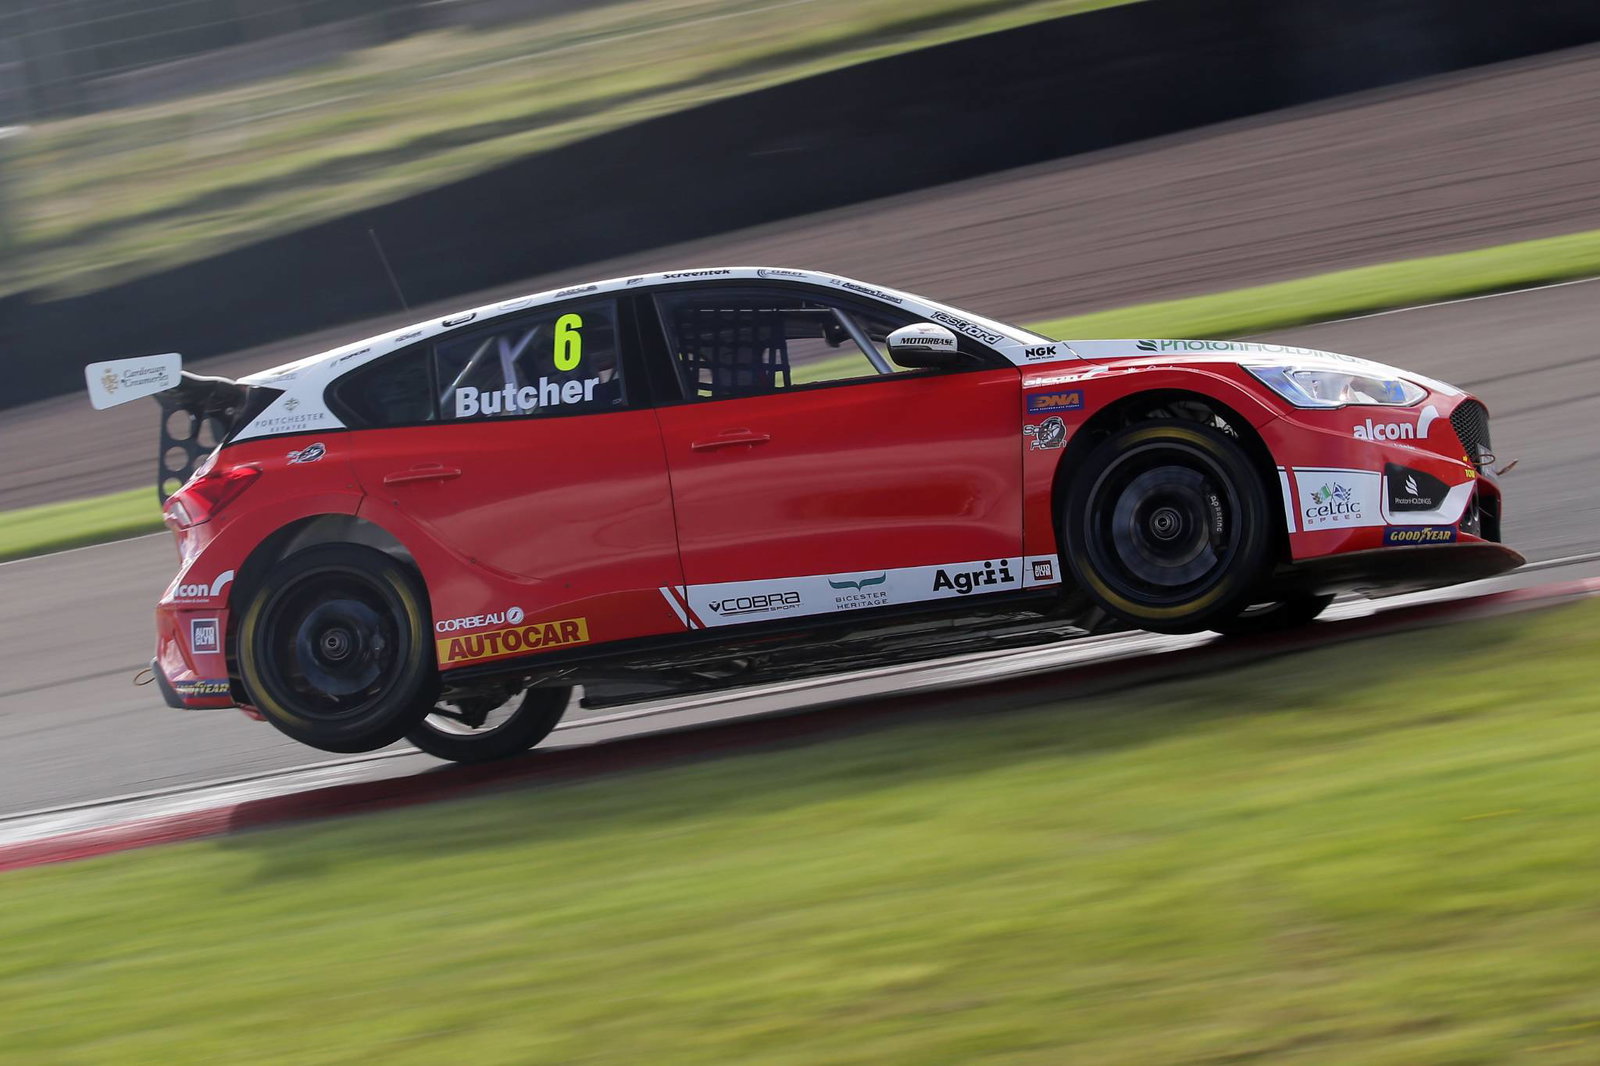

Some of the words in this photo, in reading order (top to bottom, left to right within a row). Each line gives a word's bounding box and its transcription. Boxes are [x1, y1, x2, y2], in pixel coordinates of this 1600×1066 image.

[662, 269, 731, 280] Screentek
[553, 313, 583, 372] 6
[900, 337, 954, 346] MOTORBASE
[1025, 346, 1057, 358] NGK
[455, 376, 600, 417] Butcher
[1035, 393, 1080, 408] DNA
[255, 412, 324, 428] PORTCHESTER
[270, 423, 307, 433] ESTATES
[1353, 418, 1414, 441] alcon
[1307, 513, 1362, 525] SPEED
[1390, 527, 1452, 543] GOODYEAR
[932, 559, 1015, 595] Agrii
[835, 591, 888, 603] BICESTER
[836, 599, 889, 610] HERITAGE
[770, 604, 800, 612] SPORT
[435, 612, 506, 634] CORBEAU
[447, 620, 581, 662] AUTOCAR
